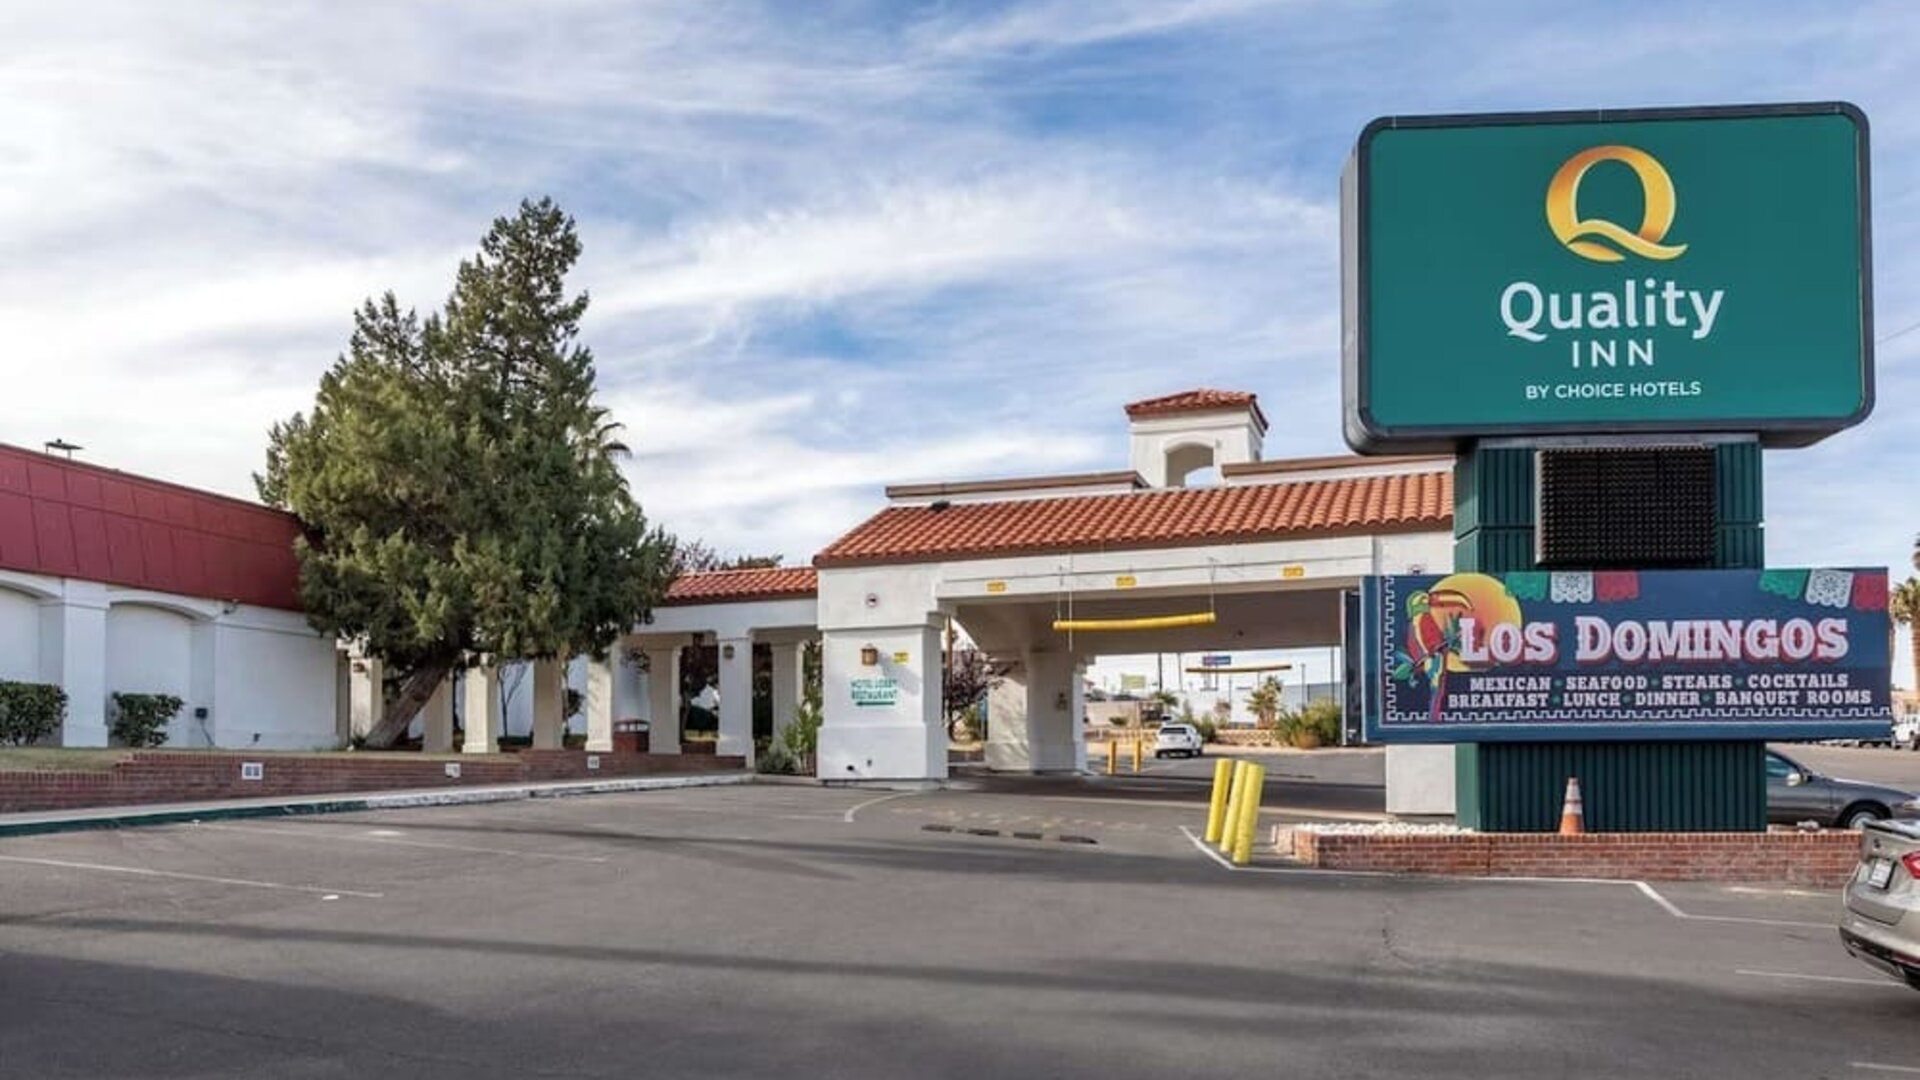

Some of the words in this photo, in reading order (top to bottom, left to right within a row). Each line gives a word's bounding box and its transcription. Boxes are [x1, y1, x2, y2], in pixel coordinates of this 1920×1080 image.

[1500, 278, 1724, 343] Quality
[1571, 339, 1655, 368] INN
[1525, 384, 1549, 400] BY
[1555, 382, 1625, 399] CHOICE
[1629, 380, 1702, 397] HOTELS
[1458, 617, 1557, 663] LOS
[1574, 615, 1849, 663] DOMINGOS
[1469, 676, 1552, 692] MEXICAN
[1565, 675, 1648, 691] SEAFOOD
[1661, 674, 1733, 690] STEAKS
[1746, 673, 1849, 690] COCKTAILS
[1447, 692, 1549, 709] BREAKFAST
[1562, 692, 1621, 708] LUNCH
[1634, 691, 1701, 707] DINNER
[1714, 690, 1800, 707] BANQUET
[1806, 689, 1872, 706] ROOMS
